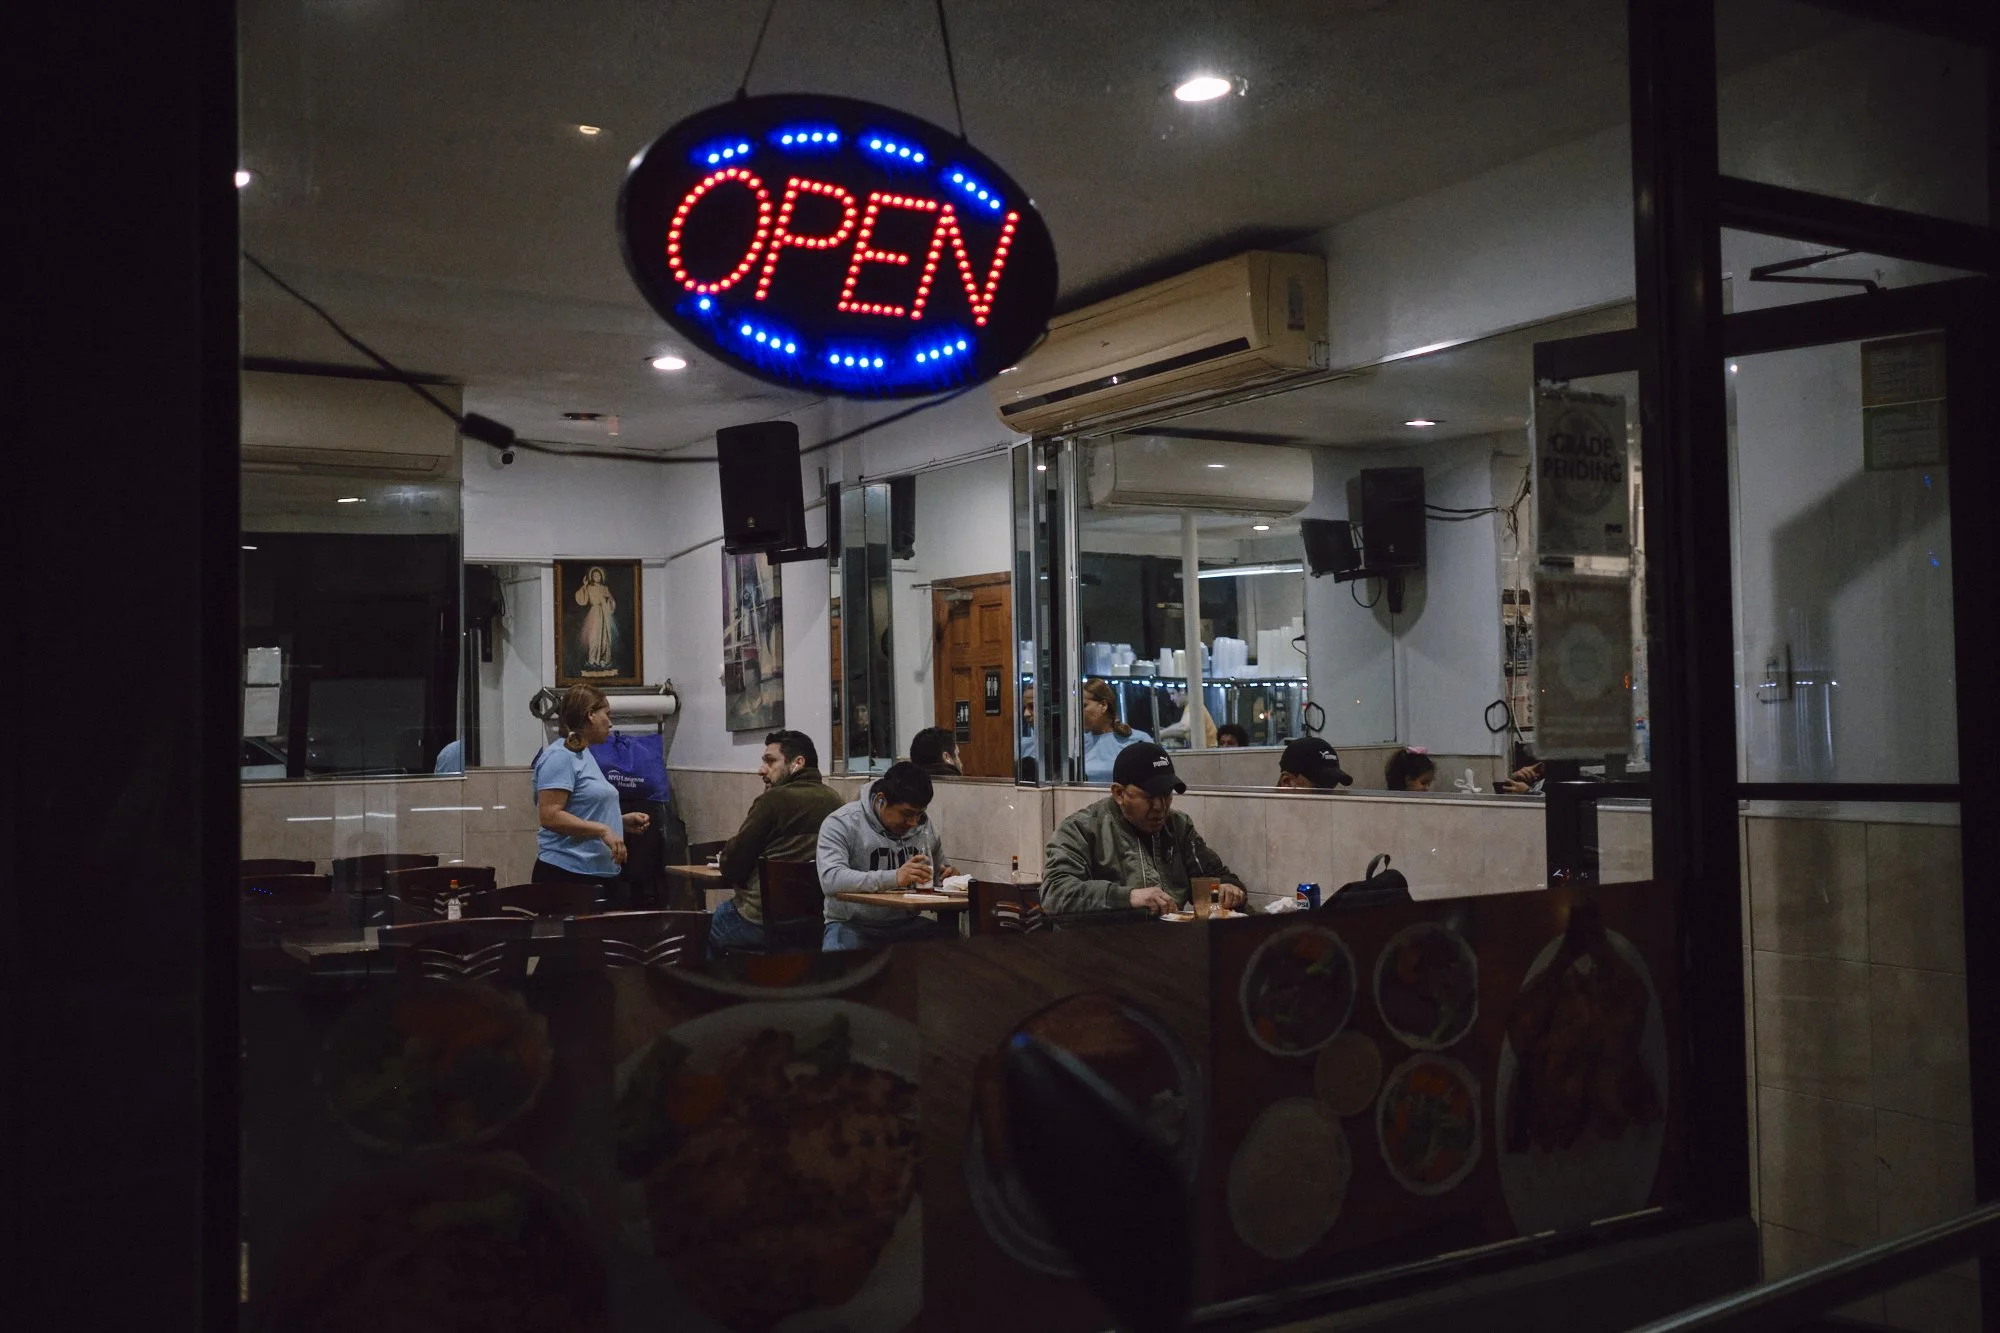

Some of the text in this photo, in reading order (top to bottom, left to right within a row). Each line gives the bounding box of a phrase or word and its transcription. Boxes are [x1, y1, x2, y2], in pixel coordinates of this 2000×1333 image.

[667, 167, 1022, 327] OPEN
[1550, 434, 1613, 458] GRADE
[1543, 457, 1622, 483] PENDING
